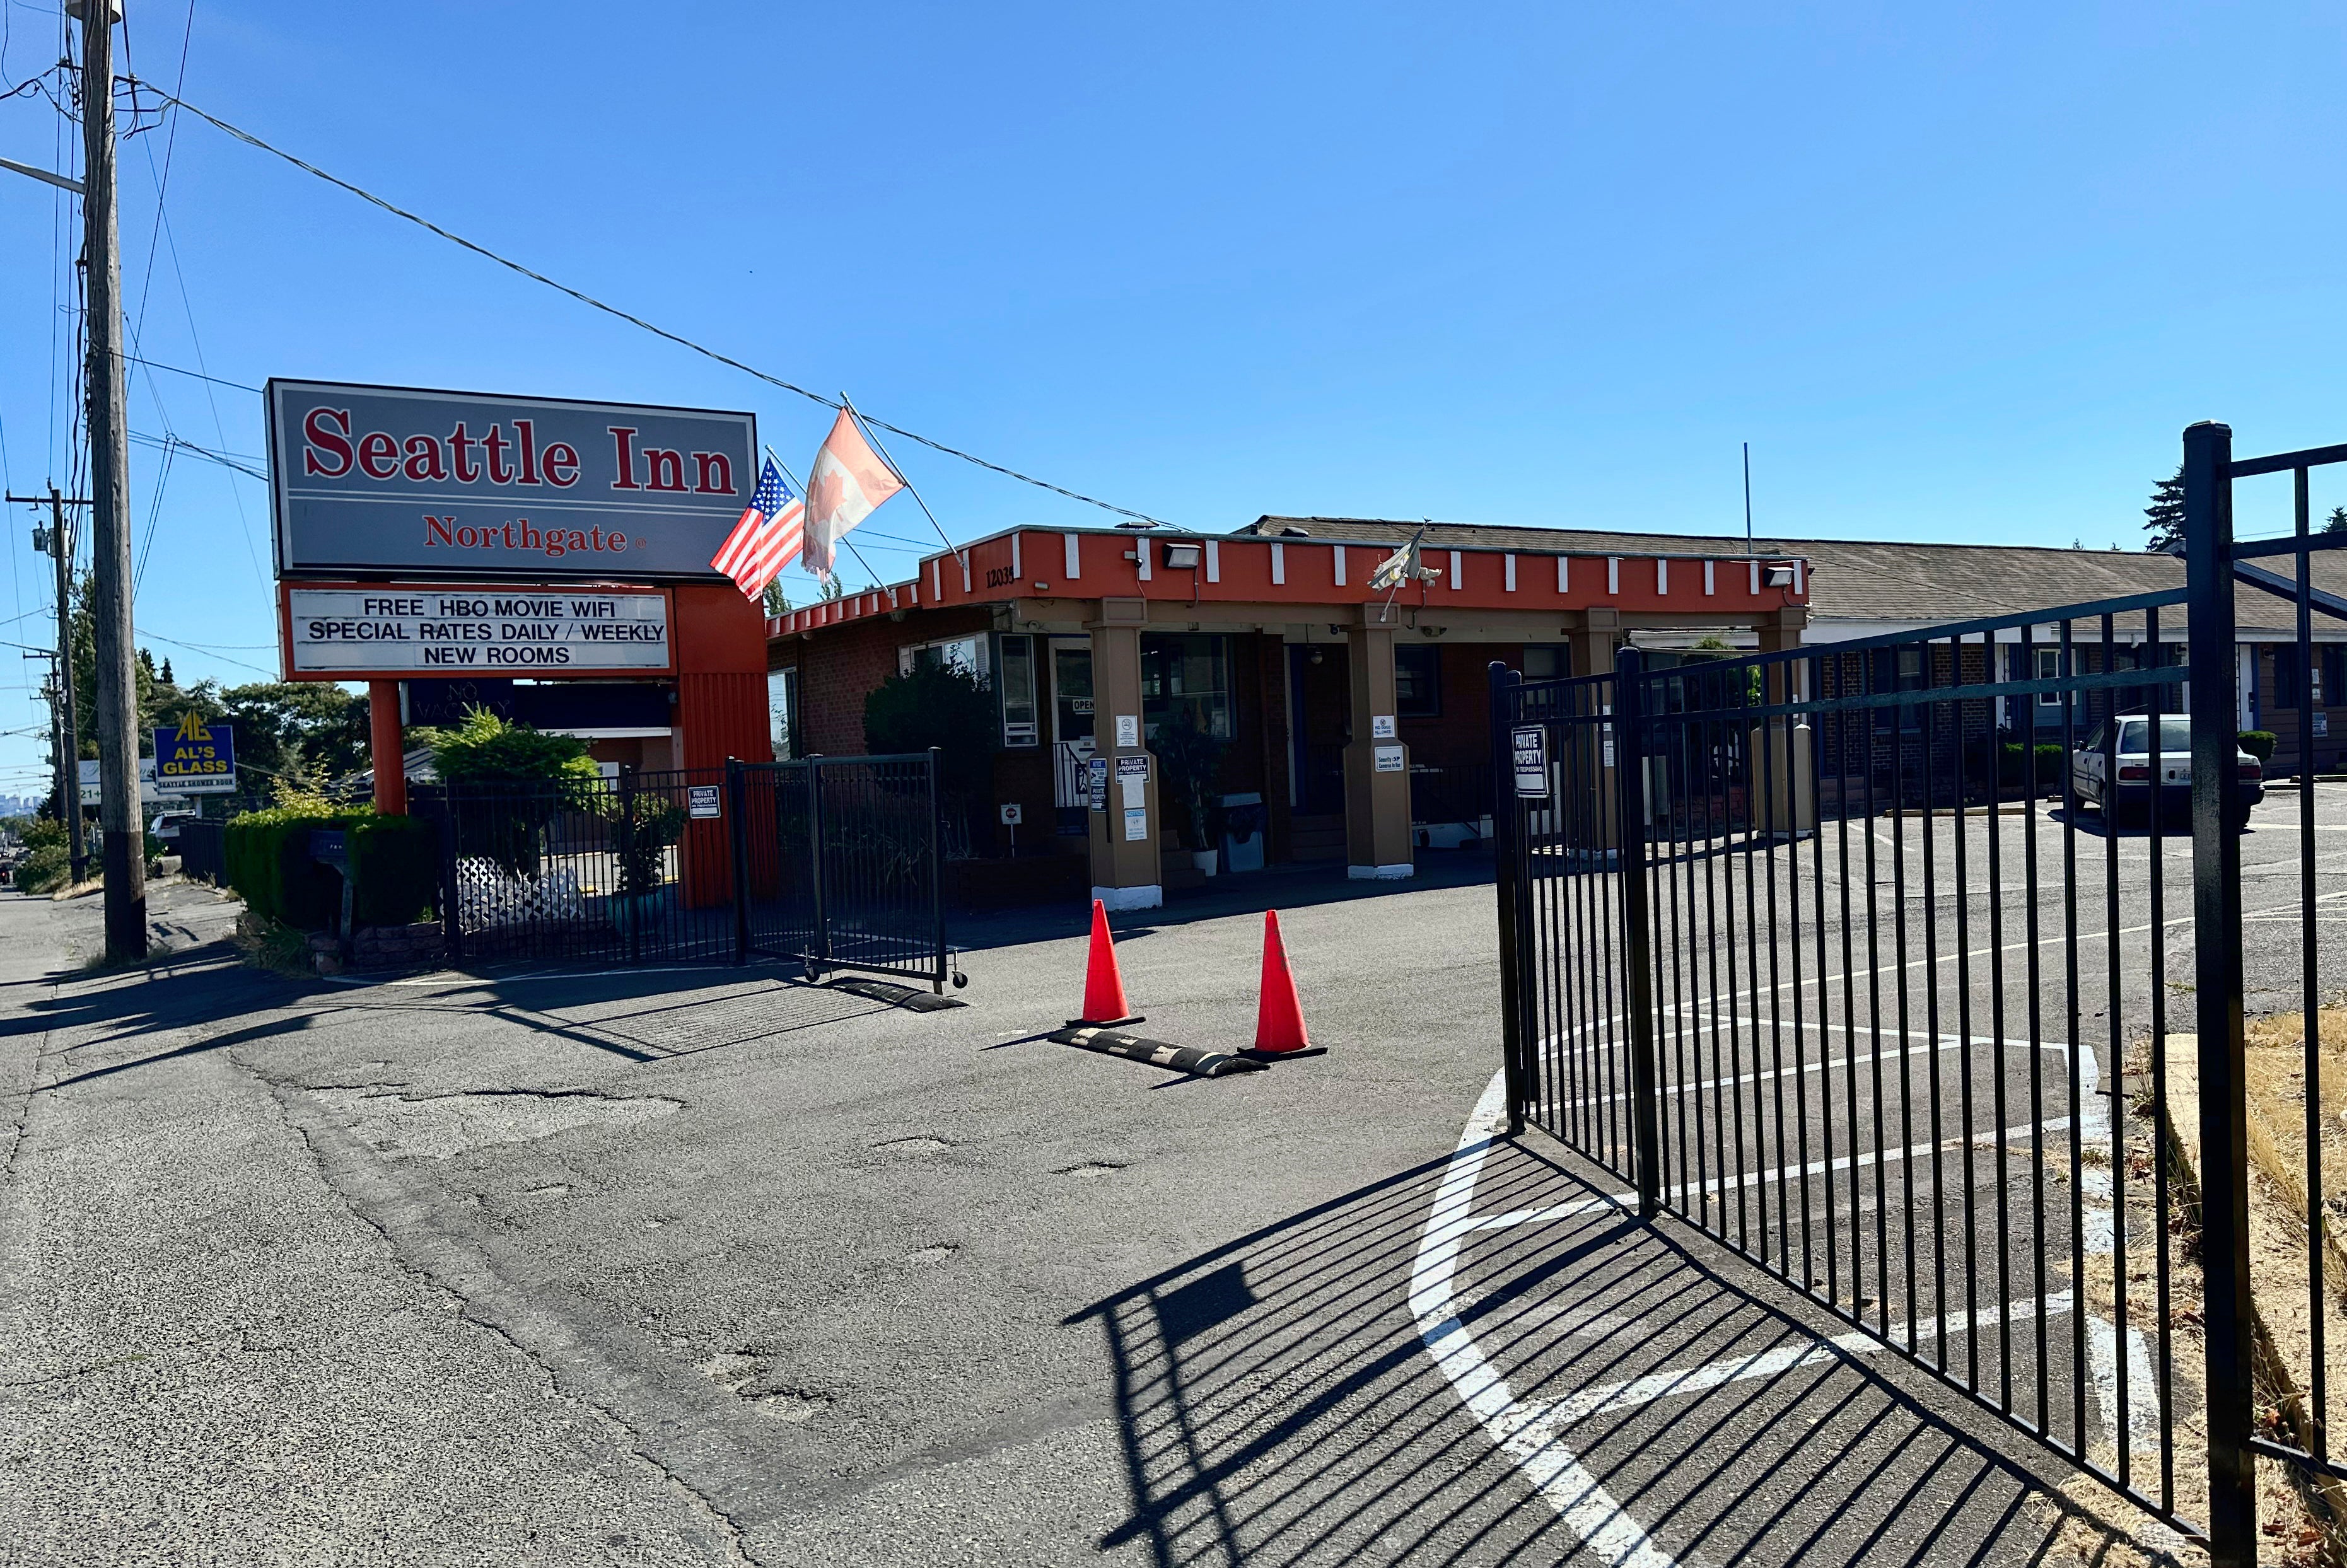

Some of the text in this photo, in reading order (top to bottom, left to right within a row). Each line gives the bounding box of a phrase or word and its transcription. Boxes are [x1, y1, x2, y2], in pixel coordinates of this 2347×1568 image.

[303, 405, 738, 496] Seattle Inn
[423, 515, 627, 557] Northgate
[364, 598, 615, 618] FREE HBO MOVIE WIFI
[308, 621, 411, 641] SPECIAL
[419, 622, 492, 641] RATES
[501, 623, 560, 641] DAILY
[580, 624, 665, 642] WEEKLY
[424, 647, 571, 665] NEW ROOMS
[446, 682, 477, 701] NO
[1074, 700, 1095, 710] OPEN
[1515, 733, 1538, 749] PRIVATE
[174, 746, 216, 760] AL'S
[1515, 749, 1542, 765] PROPERTY
[163, 759, 228, 775] GLASS
[158, 780, 187, 789] SEATTLE
[693, 789, 714, 798] PRIVATE
